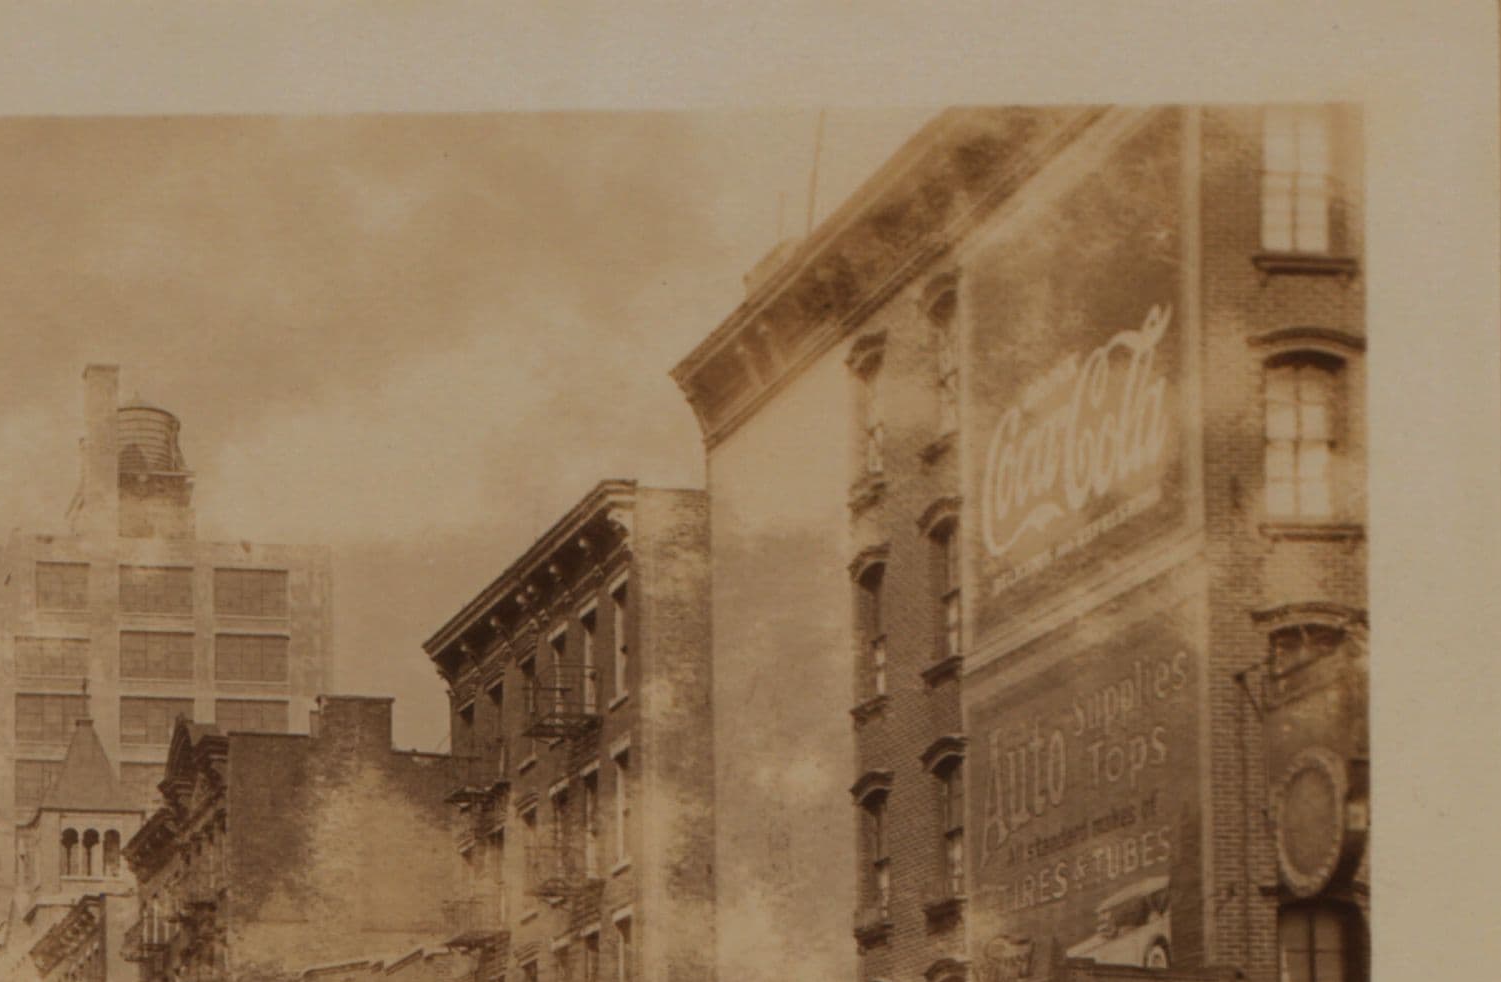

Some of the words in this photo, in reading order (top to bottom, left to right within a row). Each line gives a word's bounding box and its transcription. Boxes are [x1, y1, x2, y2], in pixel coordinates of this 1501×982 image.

[1072, 649, 1187, 737] Supplies
[980, 717, 1067, 870] Auto
[982, 862, 1068, 912] TIRES
[1092, 825, 1172, 880] TUBES
